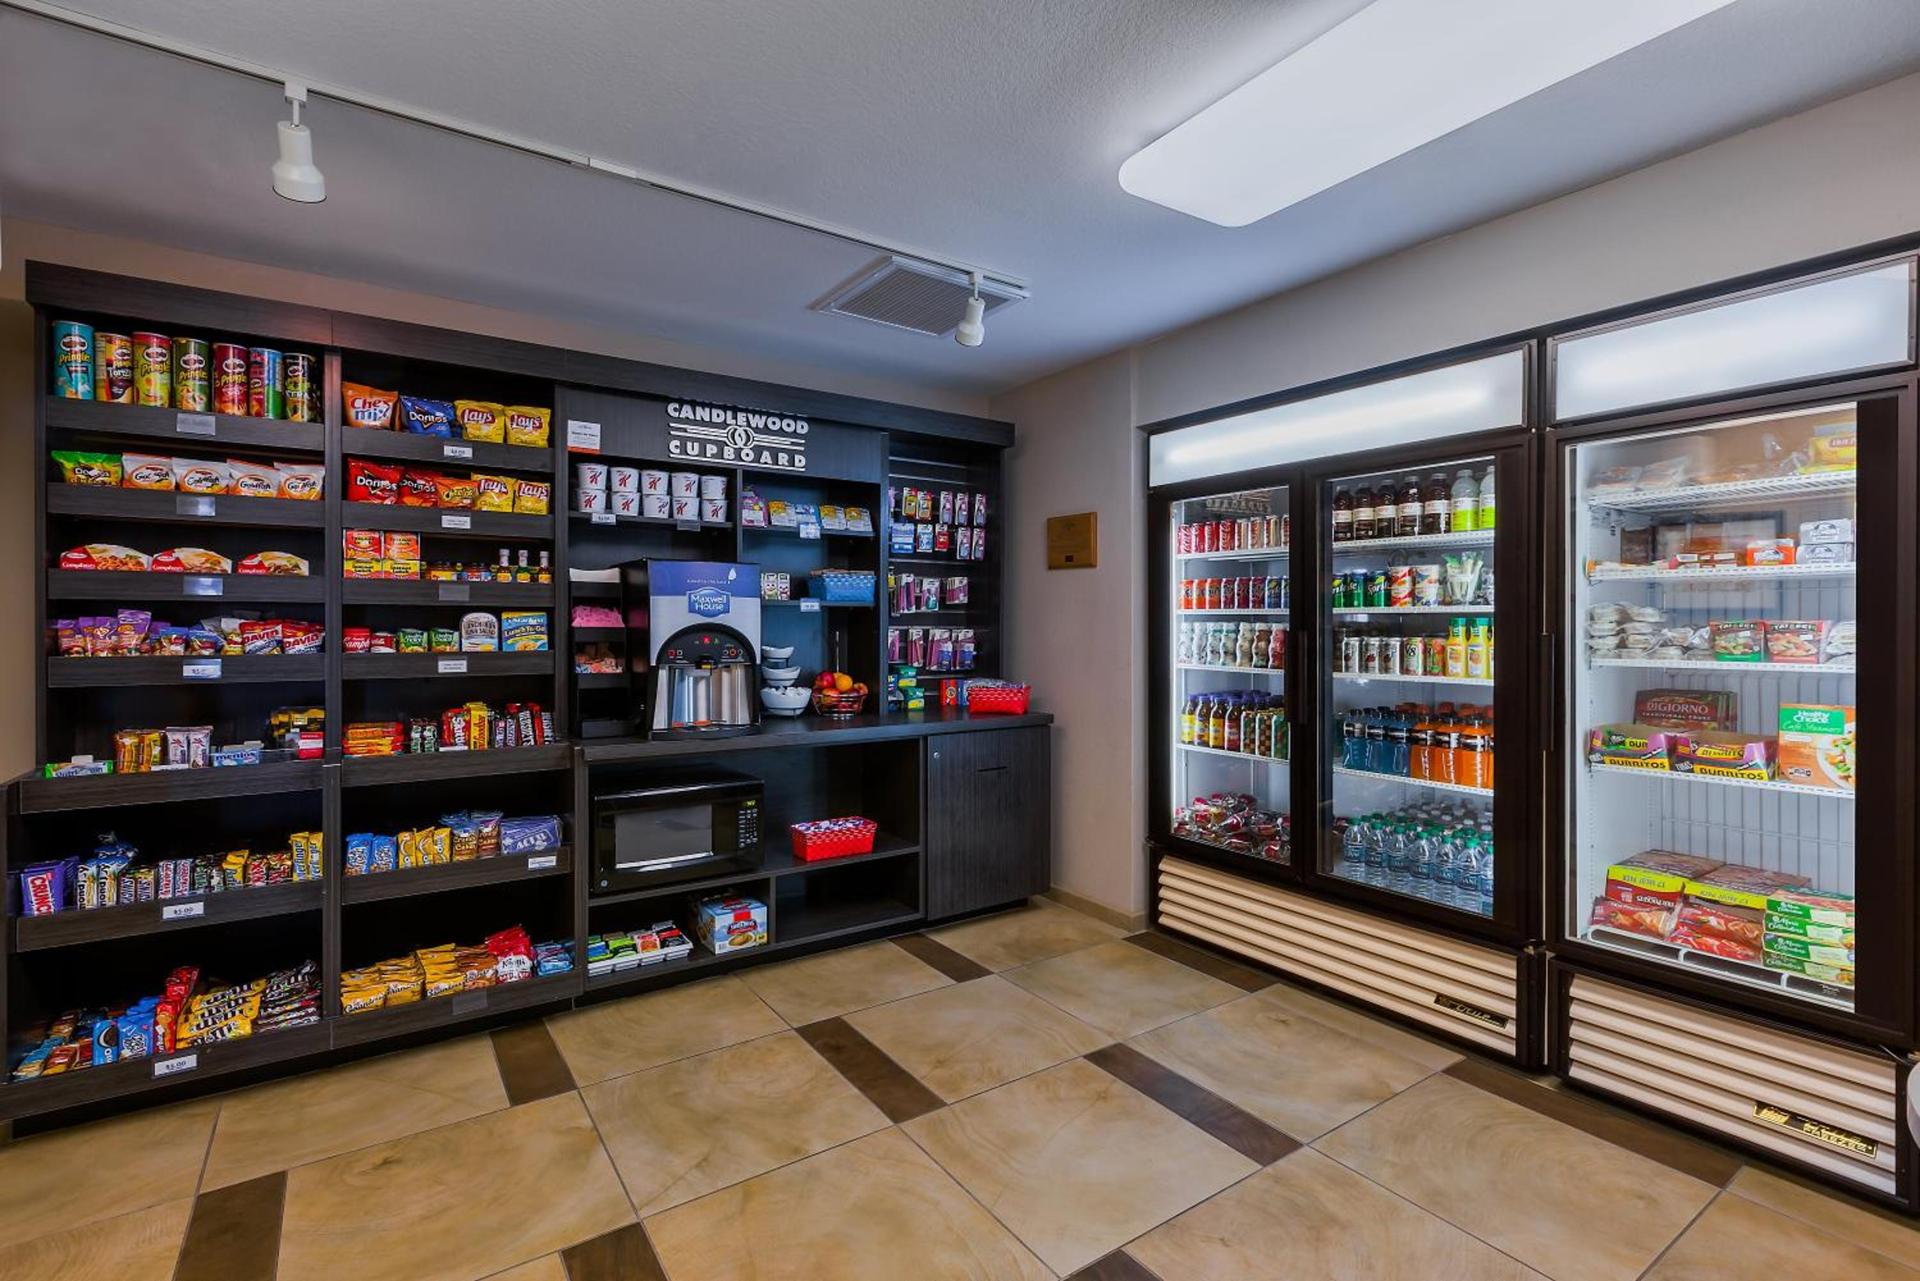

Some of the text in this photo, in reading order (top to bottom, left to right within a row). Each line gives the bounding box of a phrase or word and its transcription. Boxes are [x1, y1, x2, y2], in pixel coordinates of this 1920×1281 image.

[409, 411, 447, 423] Doritos
[667, 402, 809, 434] CANDLEWOOD
[669, 439, 806, 467] CUPBOARD
[356, 475, 397, 491] Doritos
[691, 594, 727, 604] Maxwell
[695, 603, 724, 612] House
[243, 628, 280, 642] DAVID
[284, 632, 319, 648] DAVID
[1609, 759, 1666, 769] BURRITOS
[1699, 768, 1764, 780] BURRITOS
